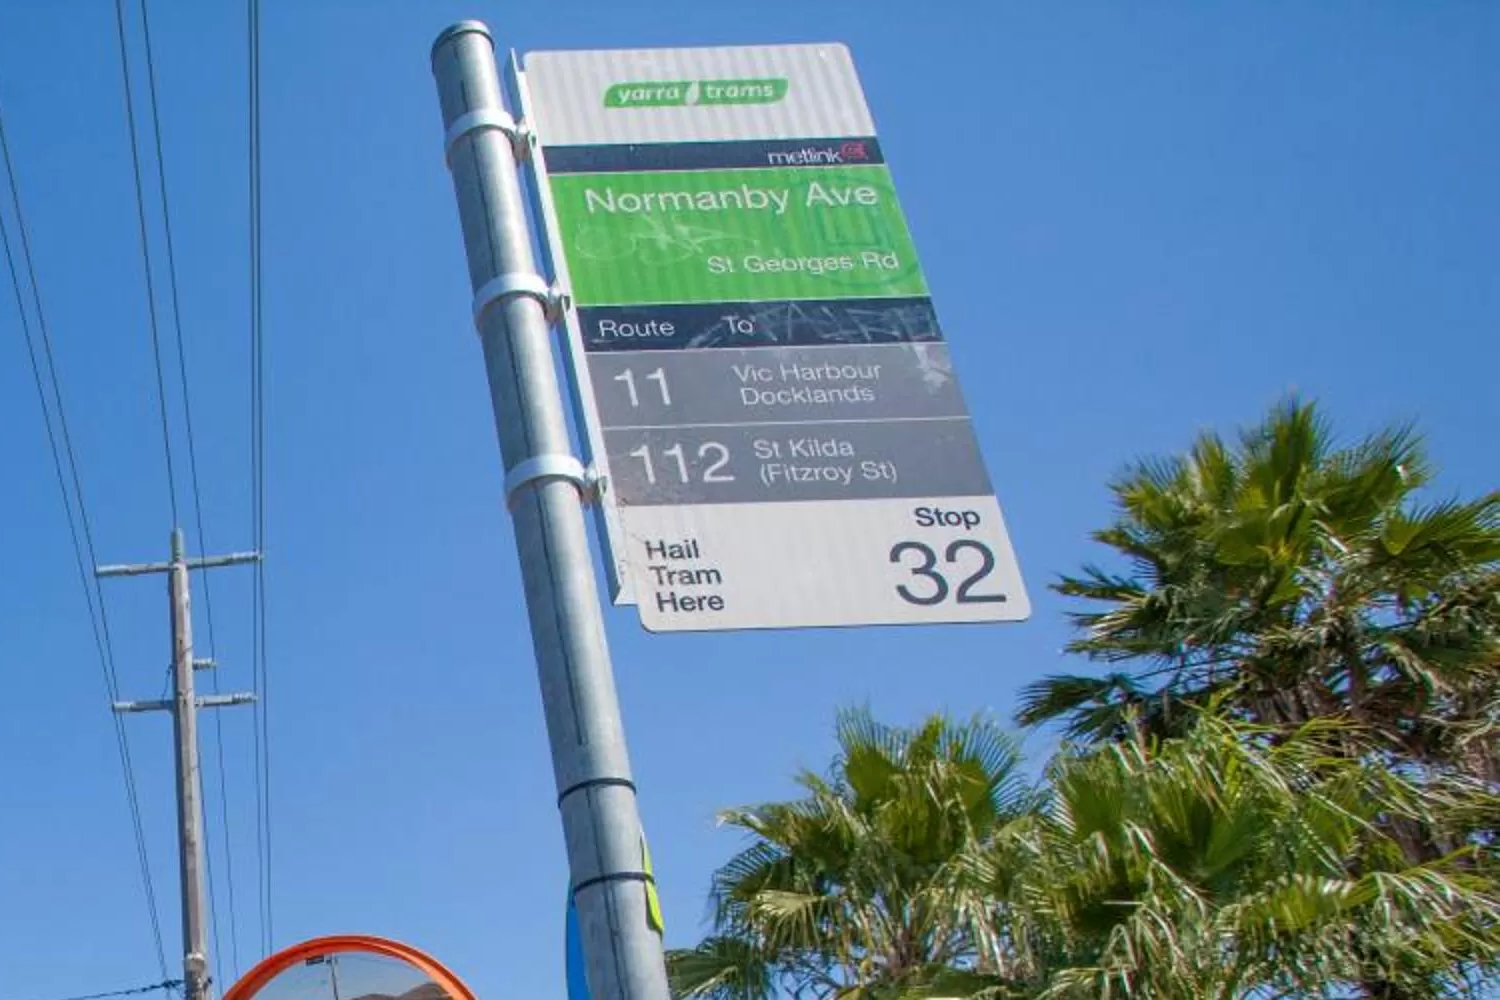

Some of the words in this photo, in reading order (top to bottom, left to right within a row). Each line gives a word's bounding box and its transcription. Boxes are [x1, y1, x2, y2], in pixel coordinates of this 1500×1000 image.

[618, 85, 680, 104] yarra
[705, 83, 773, 100] trams
[768, 150, 843, 166] metlink
[583, 184, 790, 215] Normanby
[806, 181, 878, 208] Ave
[707, 256, 734, 274] St
[744, 254, 853, 275] Georges
[862, 251, 900, 271] Rd
[599, 319, 676, 338] Route
[724, 315, 754, 335] To
[732, 364, 774, 382] Vic
[780, 363, 882, 382] Harbour
[614, 367, 672, 408] 11
[740, 386, 876, 406] Docklands
[753, 440, 784, 459] St
[789, 439, 855, 458] Kilda
[630, 441, 736, 485] 112
[759, 463, 853, 488] (Fitzroy
[860, 460, 898, 483] St)
[914, 507, 981, 531] Stop
[645, 538, 700, 561] Hail
[649, 565, 722, 586] Tram
[888, 538, 1008, 606] 32
[655, 590, 725, 613] Here
